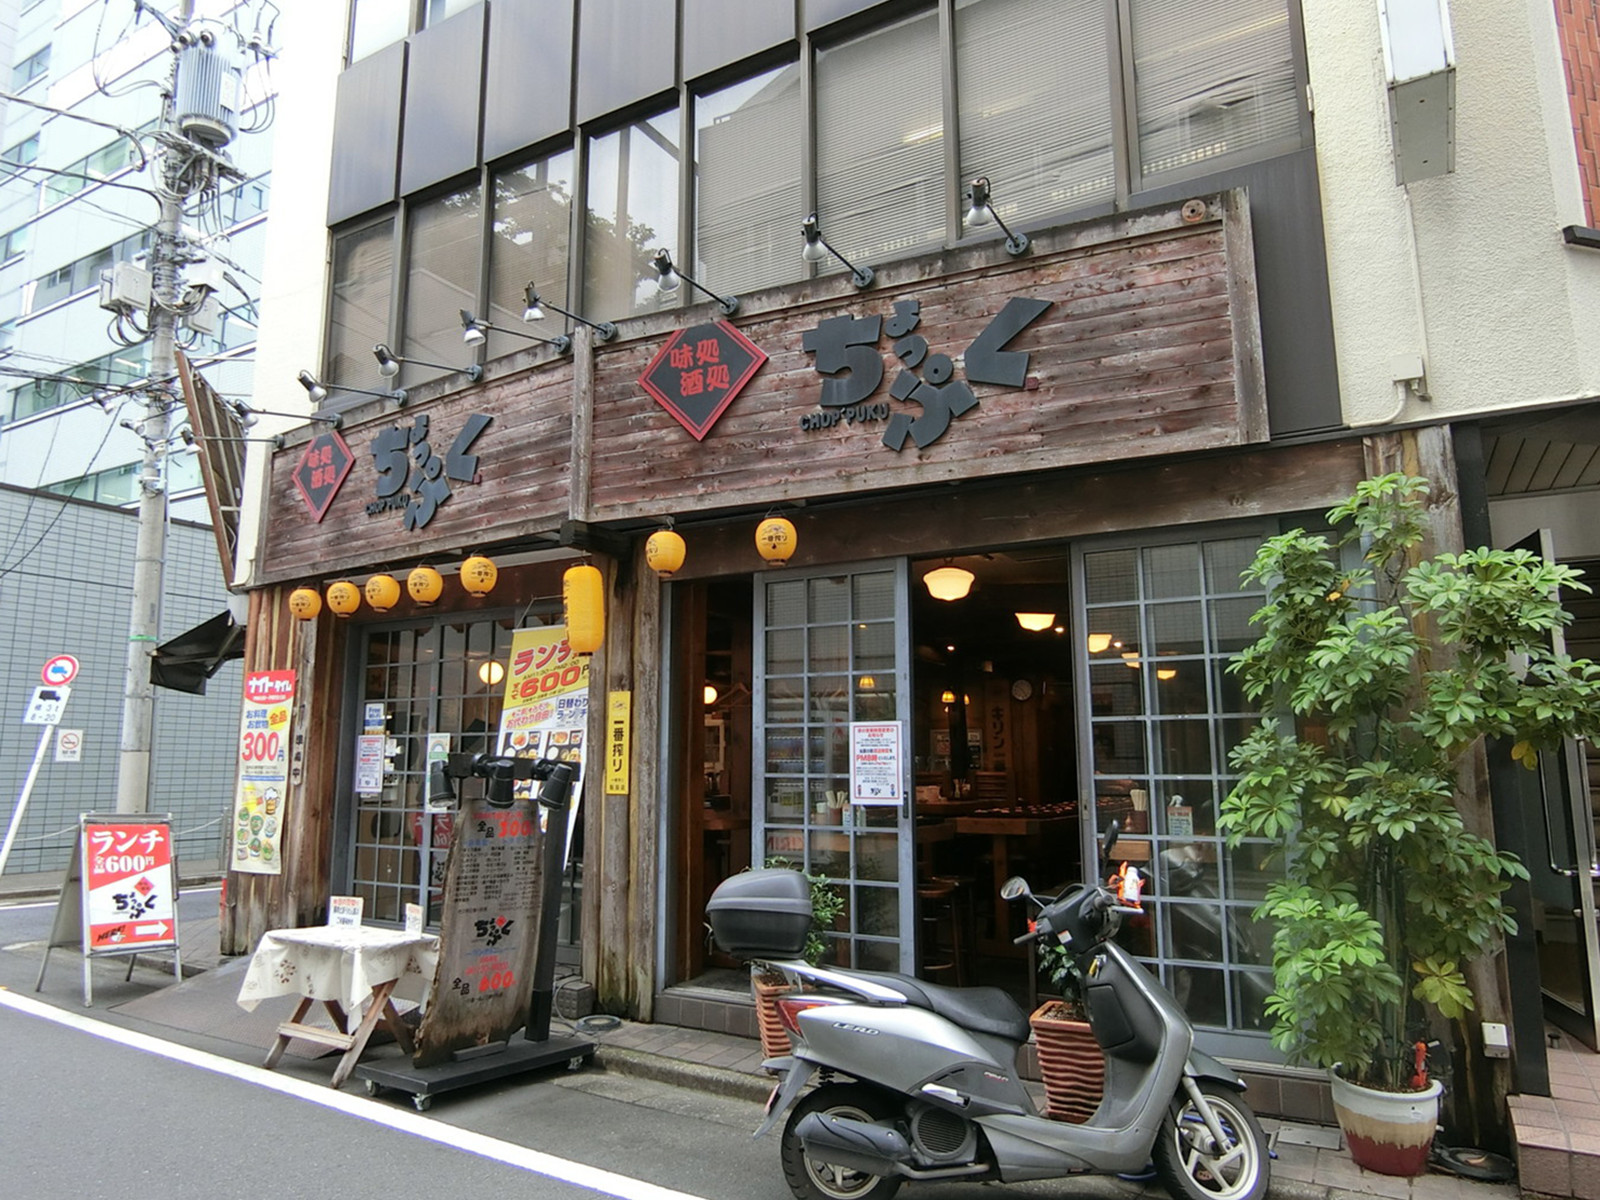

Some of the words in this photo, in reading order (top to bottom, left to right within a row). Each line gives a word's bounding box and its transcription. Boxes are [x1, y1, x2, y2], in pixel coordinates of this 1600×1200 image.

[670, 338, 720, 369] 味処
[680, 363, 730, 396] 酒処
[802, 297, 1053, 451] ちょっぷく
[370, 413, 493, 531] ちょっぷく
[612, 720, 624, 772] 一番搾り
[91, 829, 164, 854] ランチ
[477, 821, 494, 838] 全品
[105, 855, 154, 873] 600円
[112, 892, 158, 920] ちょっぷく
[474, 917, 515, 946] ちょっぷく
[452, 977, 470, 996] 全品
